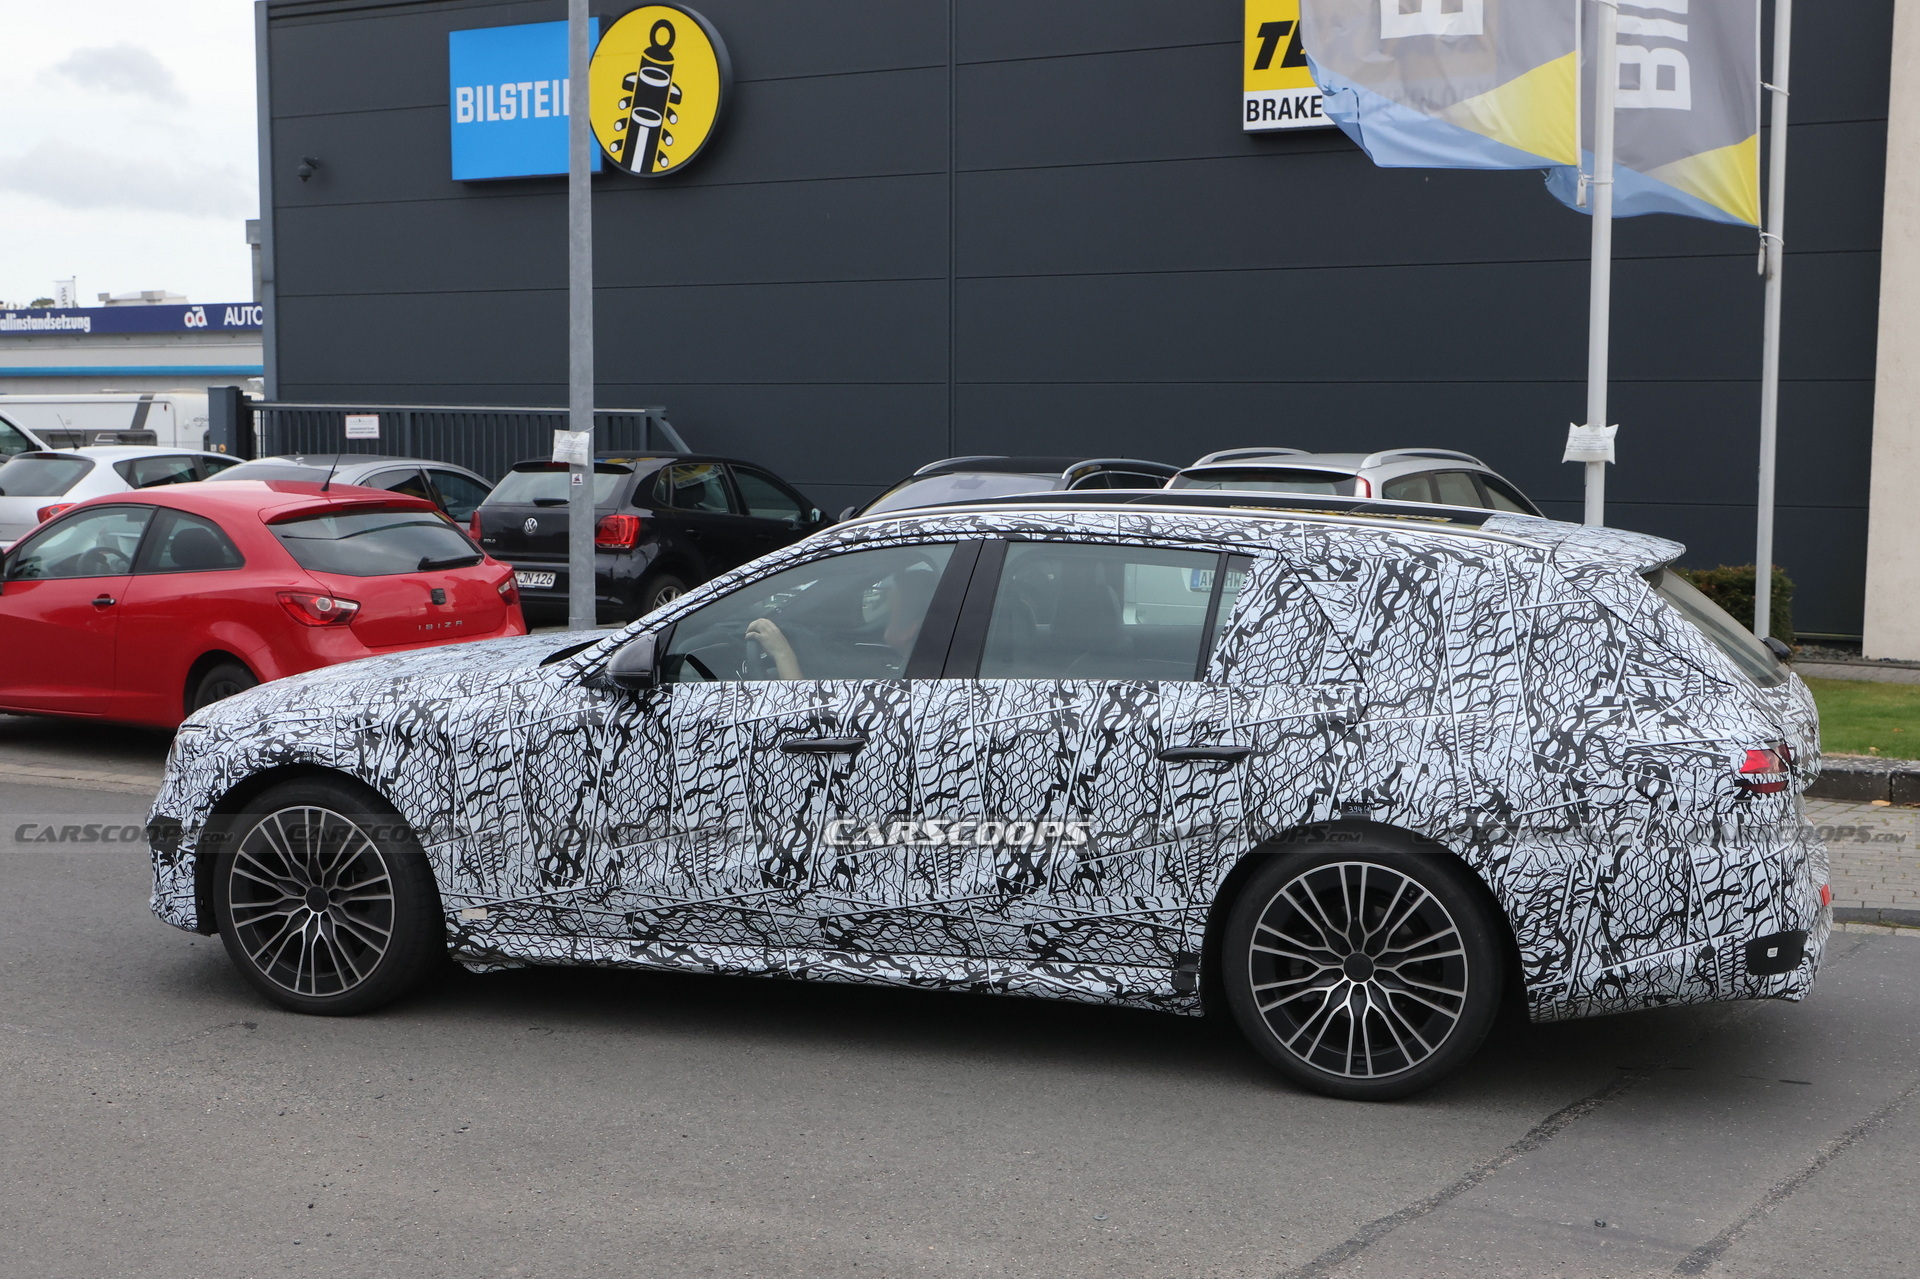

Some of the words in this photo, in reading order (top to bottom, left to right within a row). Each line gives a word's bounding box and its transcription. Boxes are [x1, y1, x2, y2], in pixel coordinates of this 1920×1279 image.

[456, 78, 570, 124] BILSTEI
[1246, 95, 1323, 122] BRAKE
[0, 312, 91, 333] allinstandsetzung
[534, 573, 553, 585] 126
[418, 620, 463, 631] IBIZA
